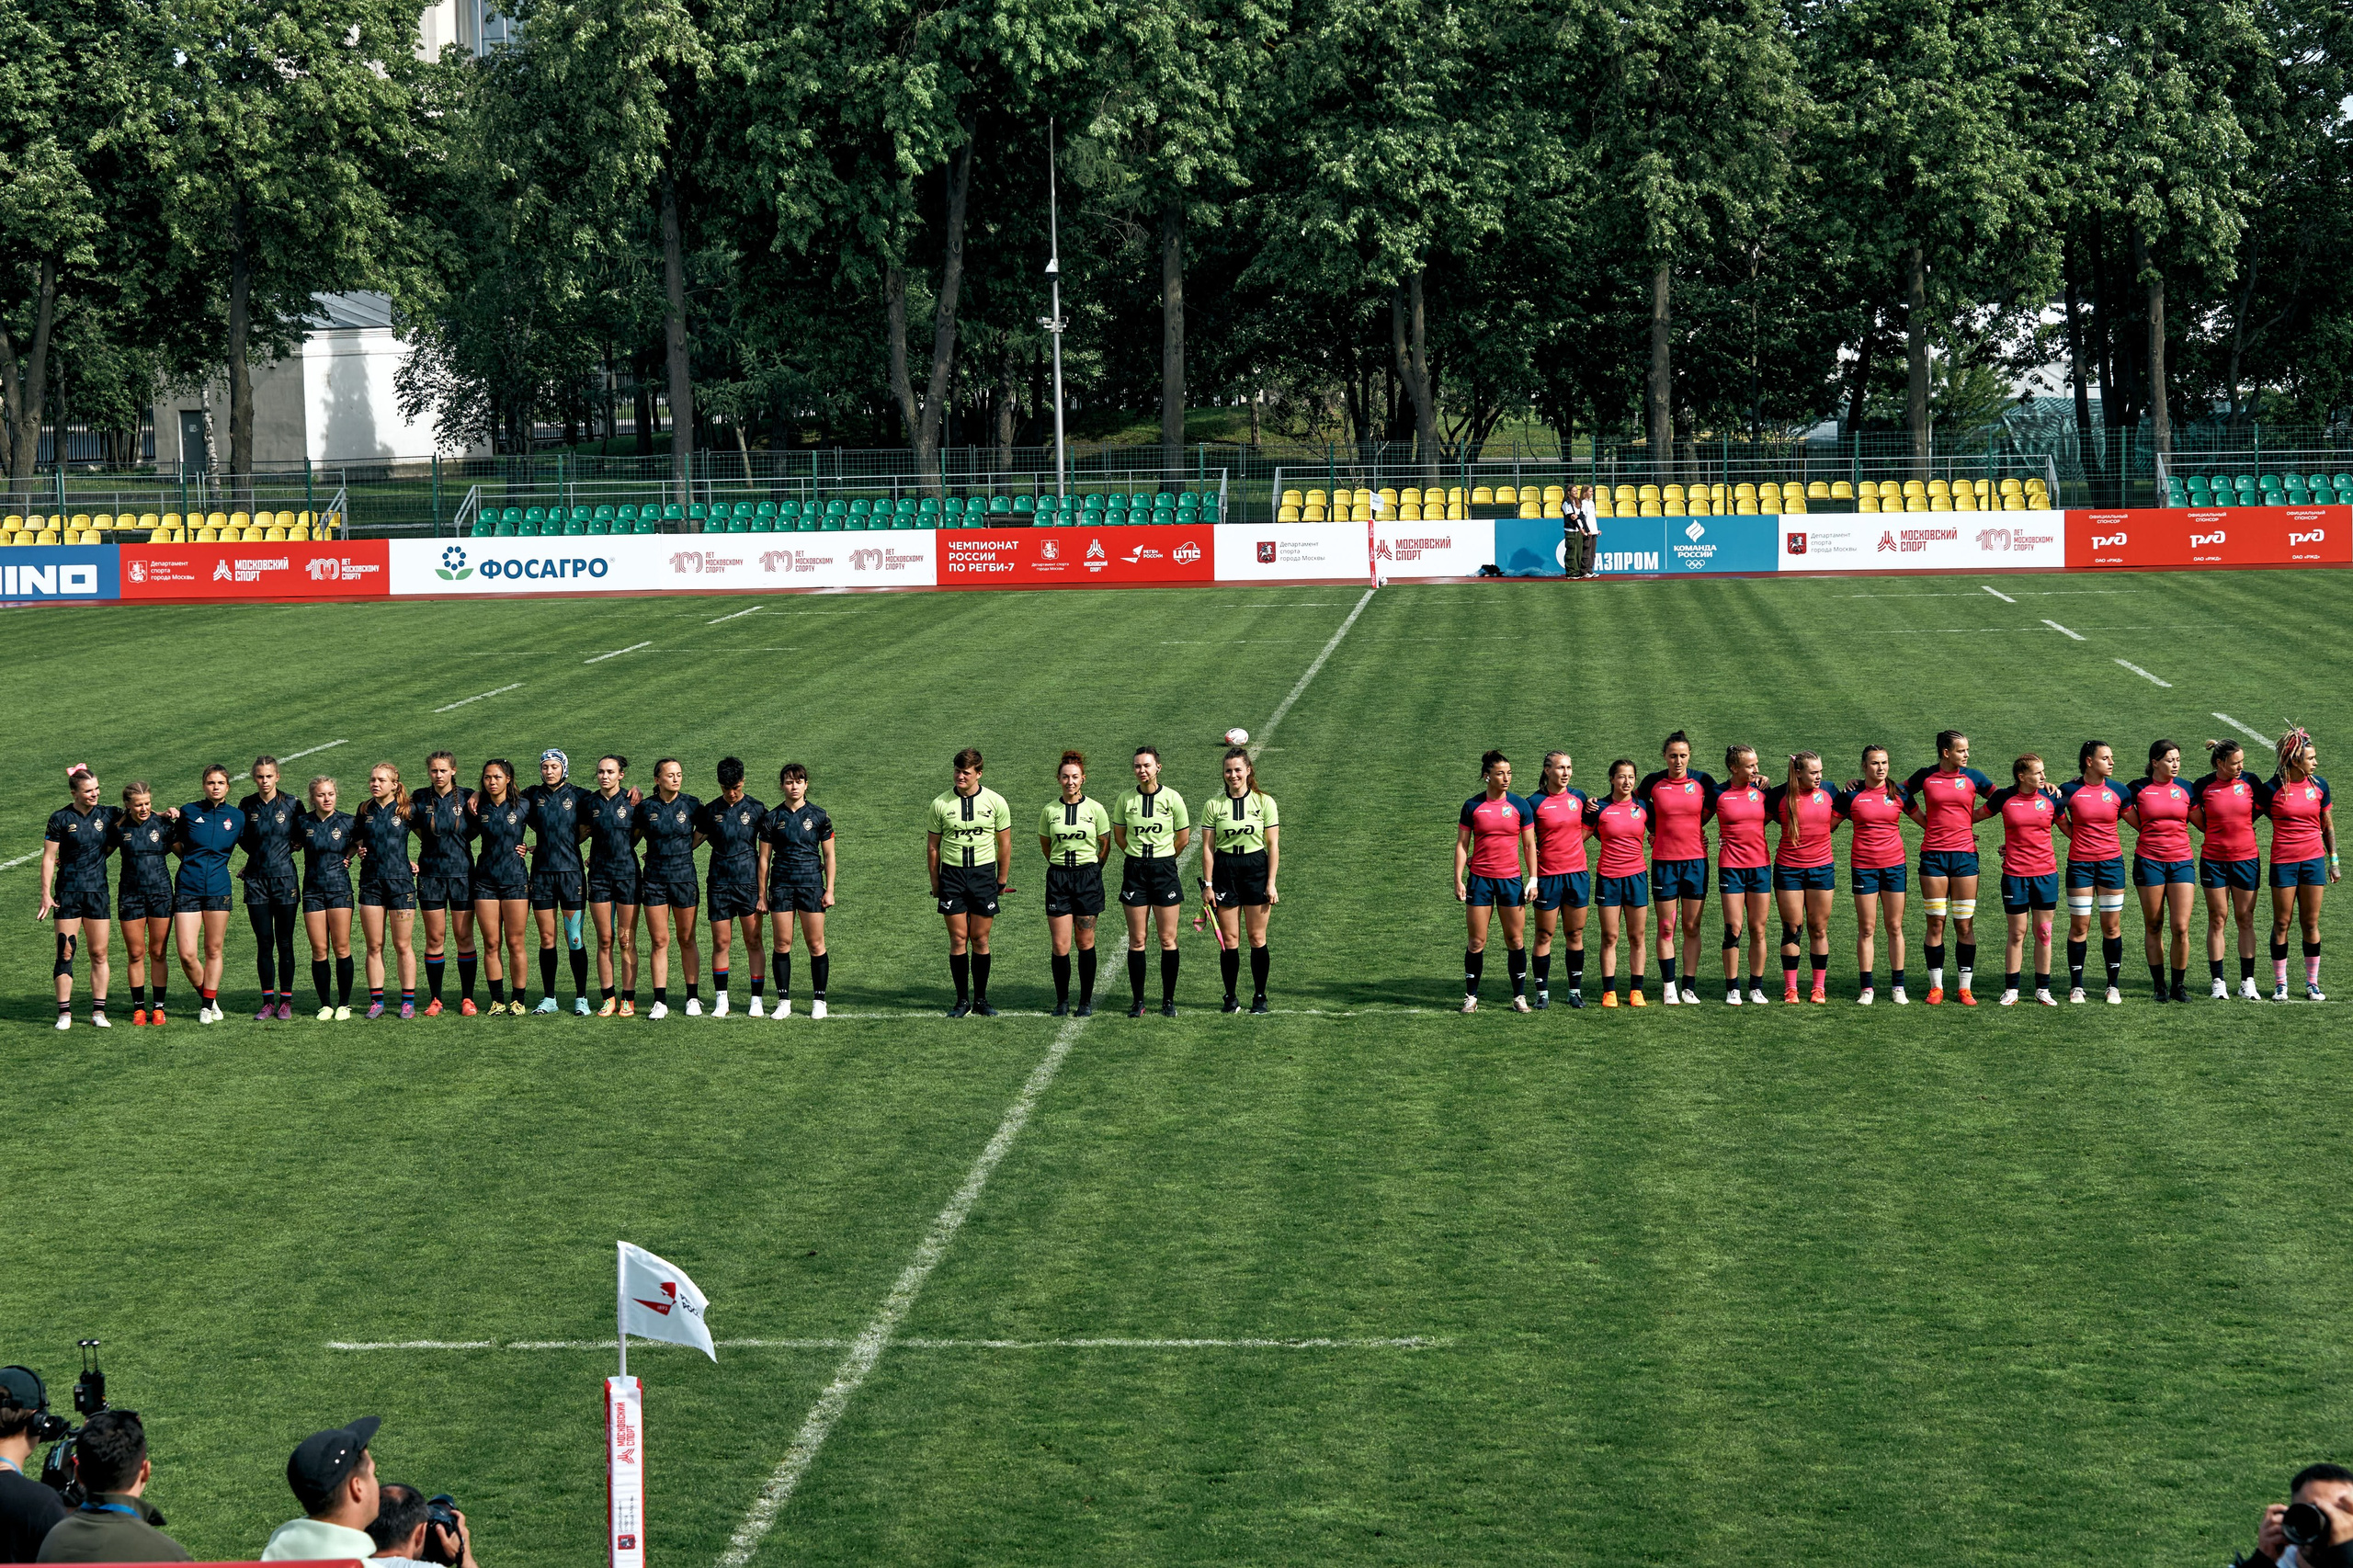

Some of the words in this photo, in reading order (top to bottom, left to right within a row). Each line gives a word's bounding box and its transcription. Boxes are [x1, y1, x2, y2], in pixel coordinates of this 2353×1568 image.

[1900, 527, 1958, 540] МОСКОВСКИЙ
[949, 540, 1019, 551] ЧЕМПИОНАТ
[1395, 536, 1451, 550] МОСКОВСКИЙ
[2014, 536, 2053, 544] МОСКОВСКОМУ
[1673, 544, 1718, 552] КОМАНДА
[1900, 541, 1927, 552] СПОРТ
[2014, 543, 2034, 551] СПОРТУ
[795, 557, 834, 565] МОСКОВСКОМУ
[949, 552, 995, 562] РОССИИ
[1395, 550, 1422, 561] СПОРТ
[1594, 551, 1659, 571] АЗПРОМ
[234, 557, 290, 570] МОСКОВСКИЙ
[479, 558, 608, 579] ФОСАГРО
[795, 564, 815, 573] СПОРТУ
[885, 562, 905, 571] СПОРТУ
[949, 563, 966, 572] ПО
[969, 562, 1015, 572] РЕГБИ-7
[0, 564, 97, 595] INO
[234, 571, 261, 581] СПОРТ
[614, 1402, 626, 1447] МОСКОВСКИЙ
[626, 1425, 635, 1447] СПОРТ
